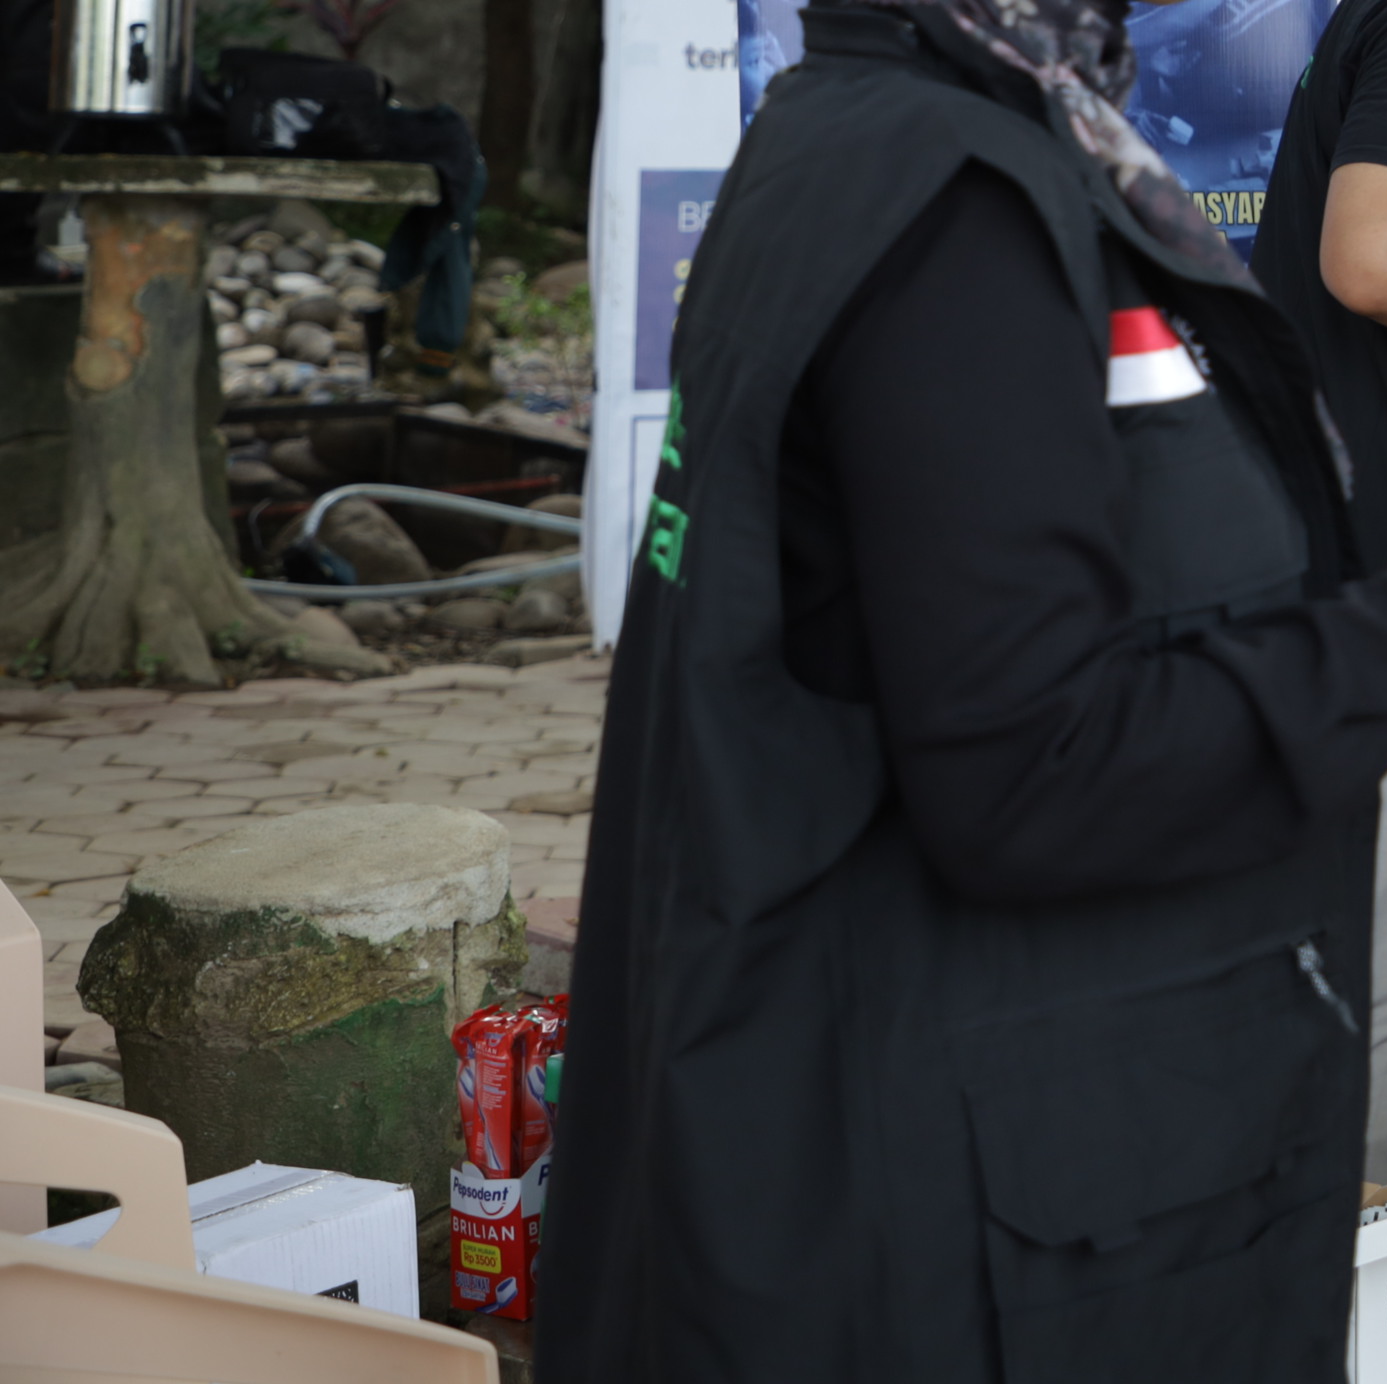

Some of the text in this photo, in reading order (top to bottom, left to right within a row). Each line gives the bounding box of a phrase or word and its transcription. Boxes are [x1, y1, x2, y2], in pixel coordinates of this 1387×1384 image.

[453, 1176, 509, 1202] Pepsodent
[452, 1215, 515, 1241] BRILIAN
[464, 1252, 475, 1265] Rp
